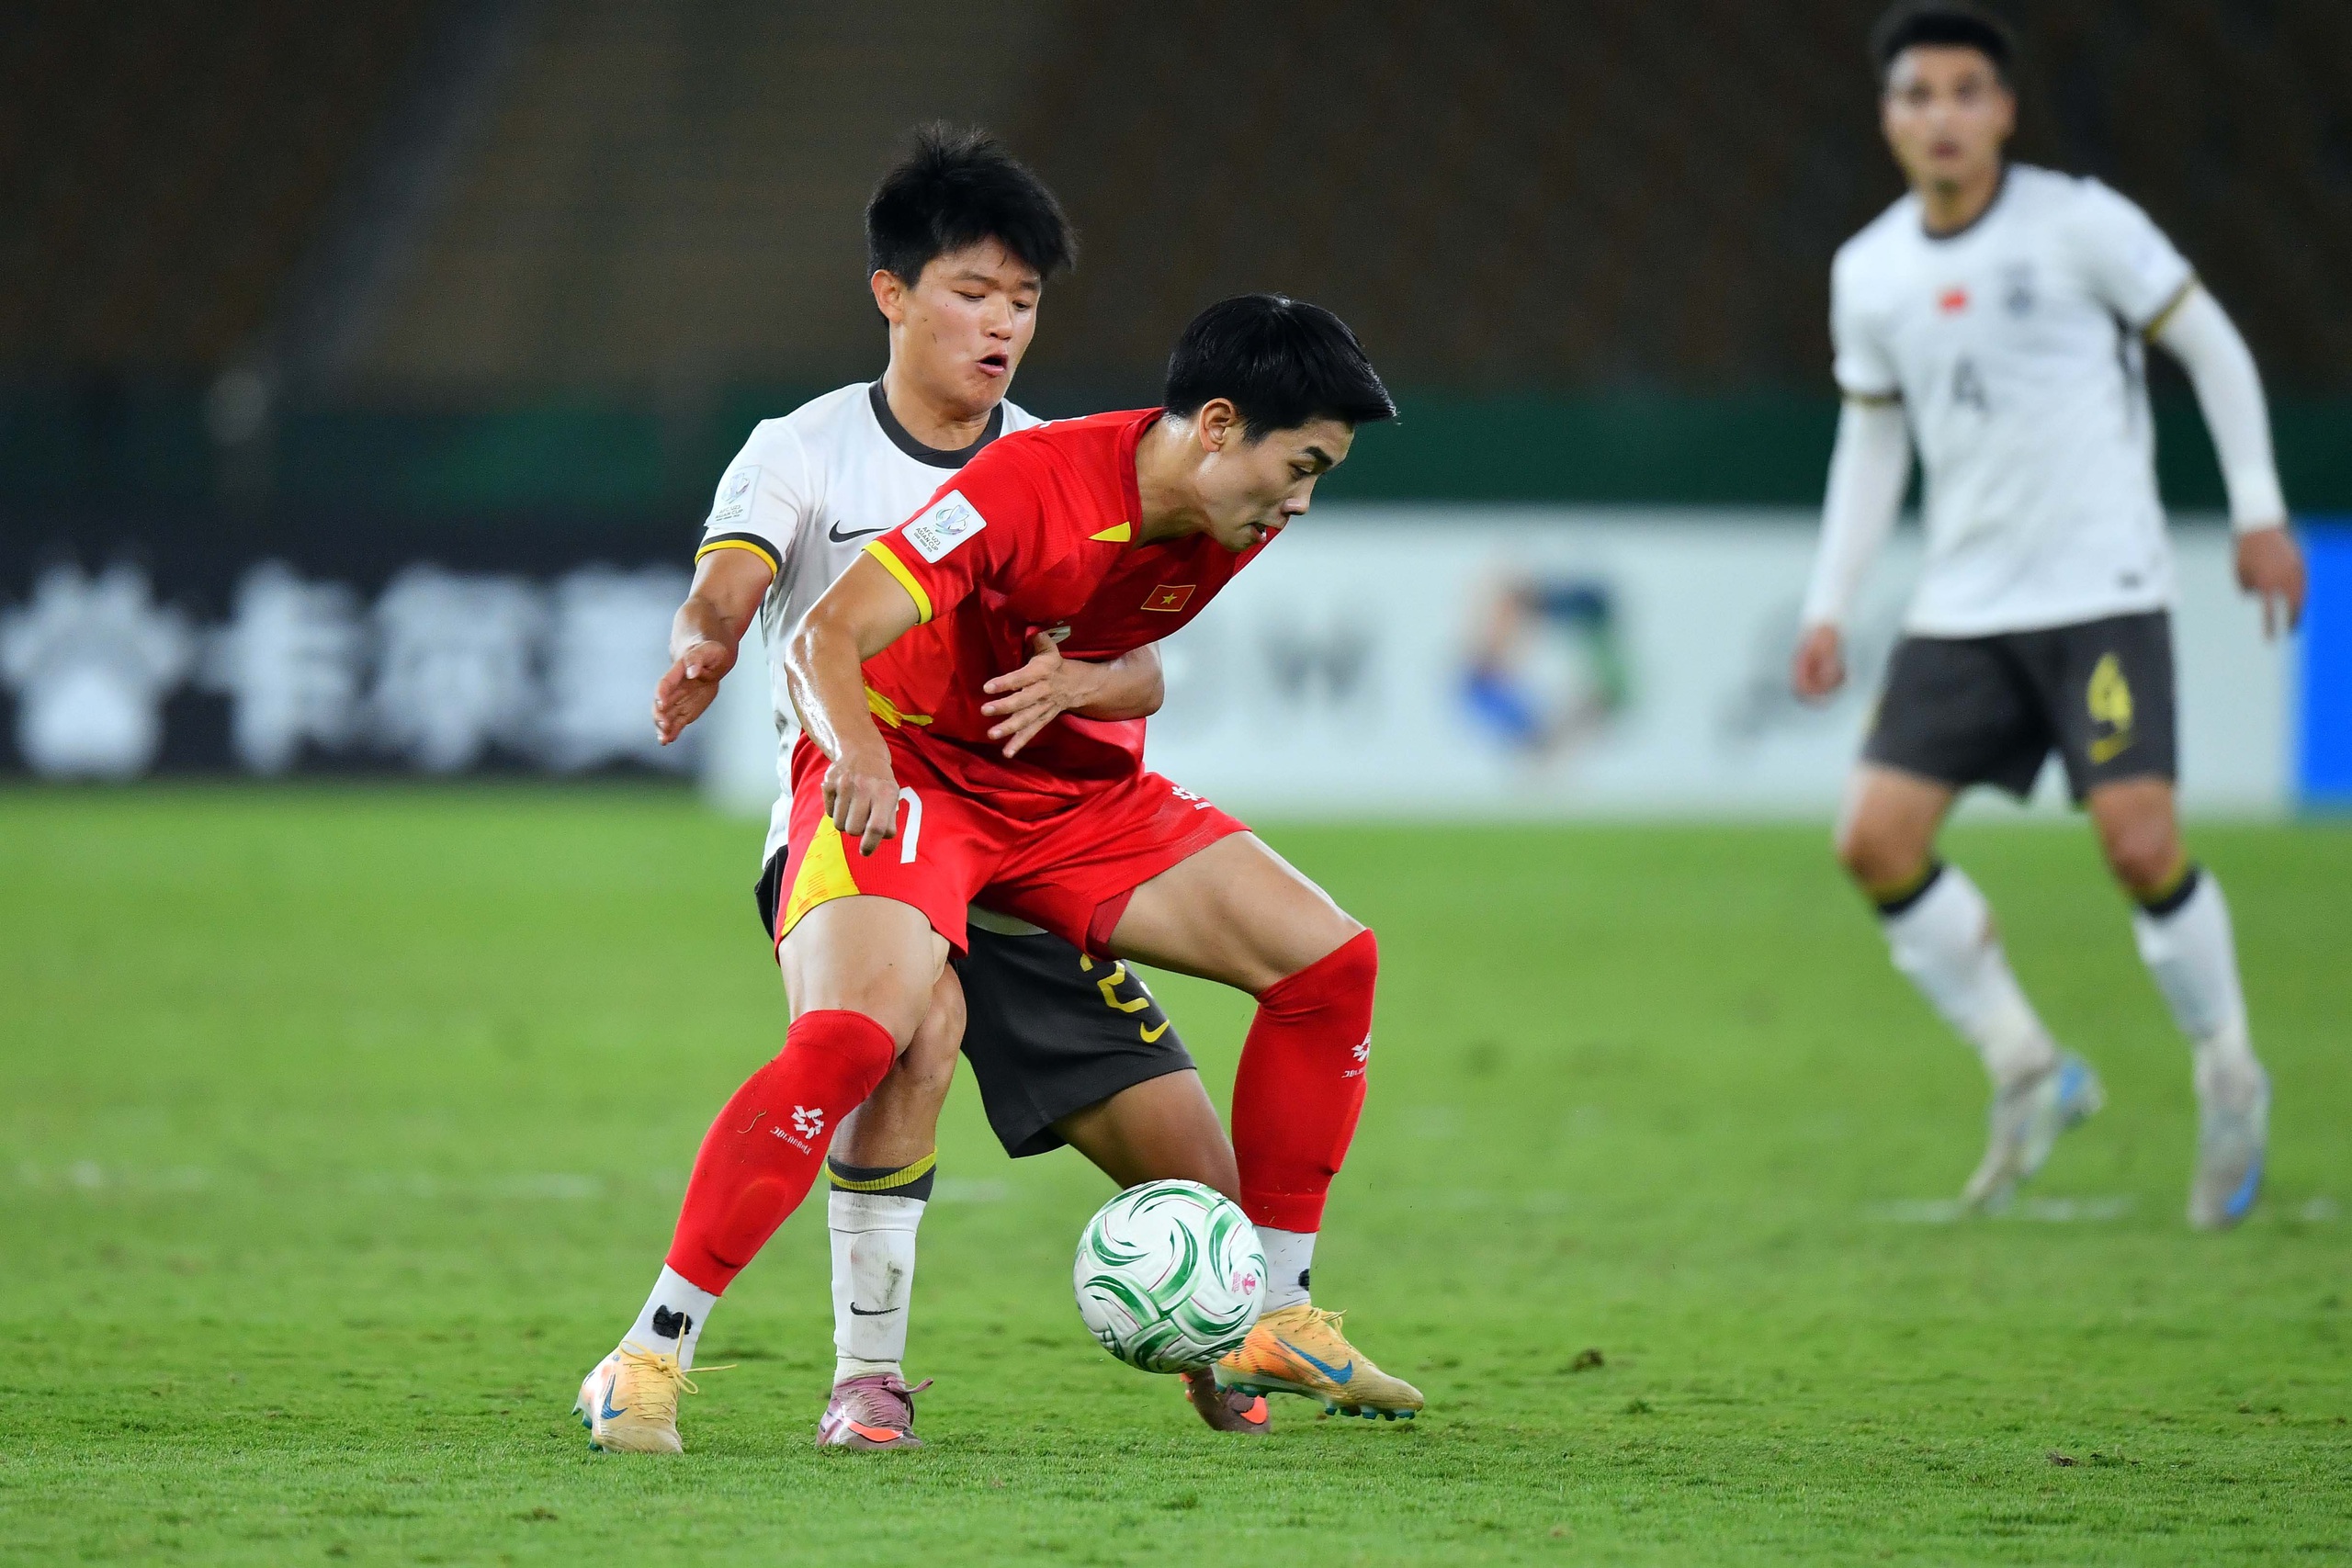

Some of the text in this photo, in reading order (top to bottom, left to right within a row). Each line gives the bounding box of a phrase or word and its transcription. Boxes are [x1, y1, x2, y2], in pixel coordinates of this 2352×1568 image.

[915, 527, 931, 542] ASIAN
[928, 541, 939, 551] CUP
[922, 526, 933, 536] AFC
[932, 536, 941, 546] U23
